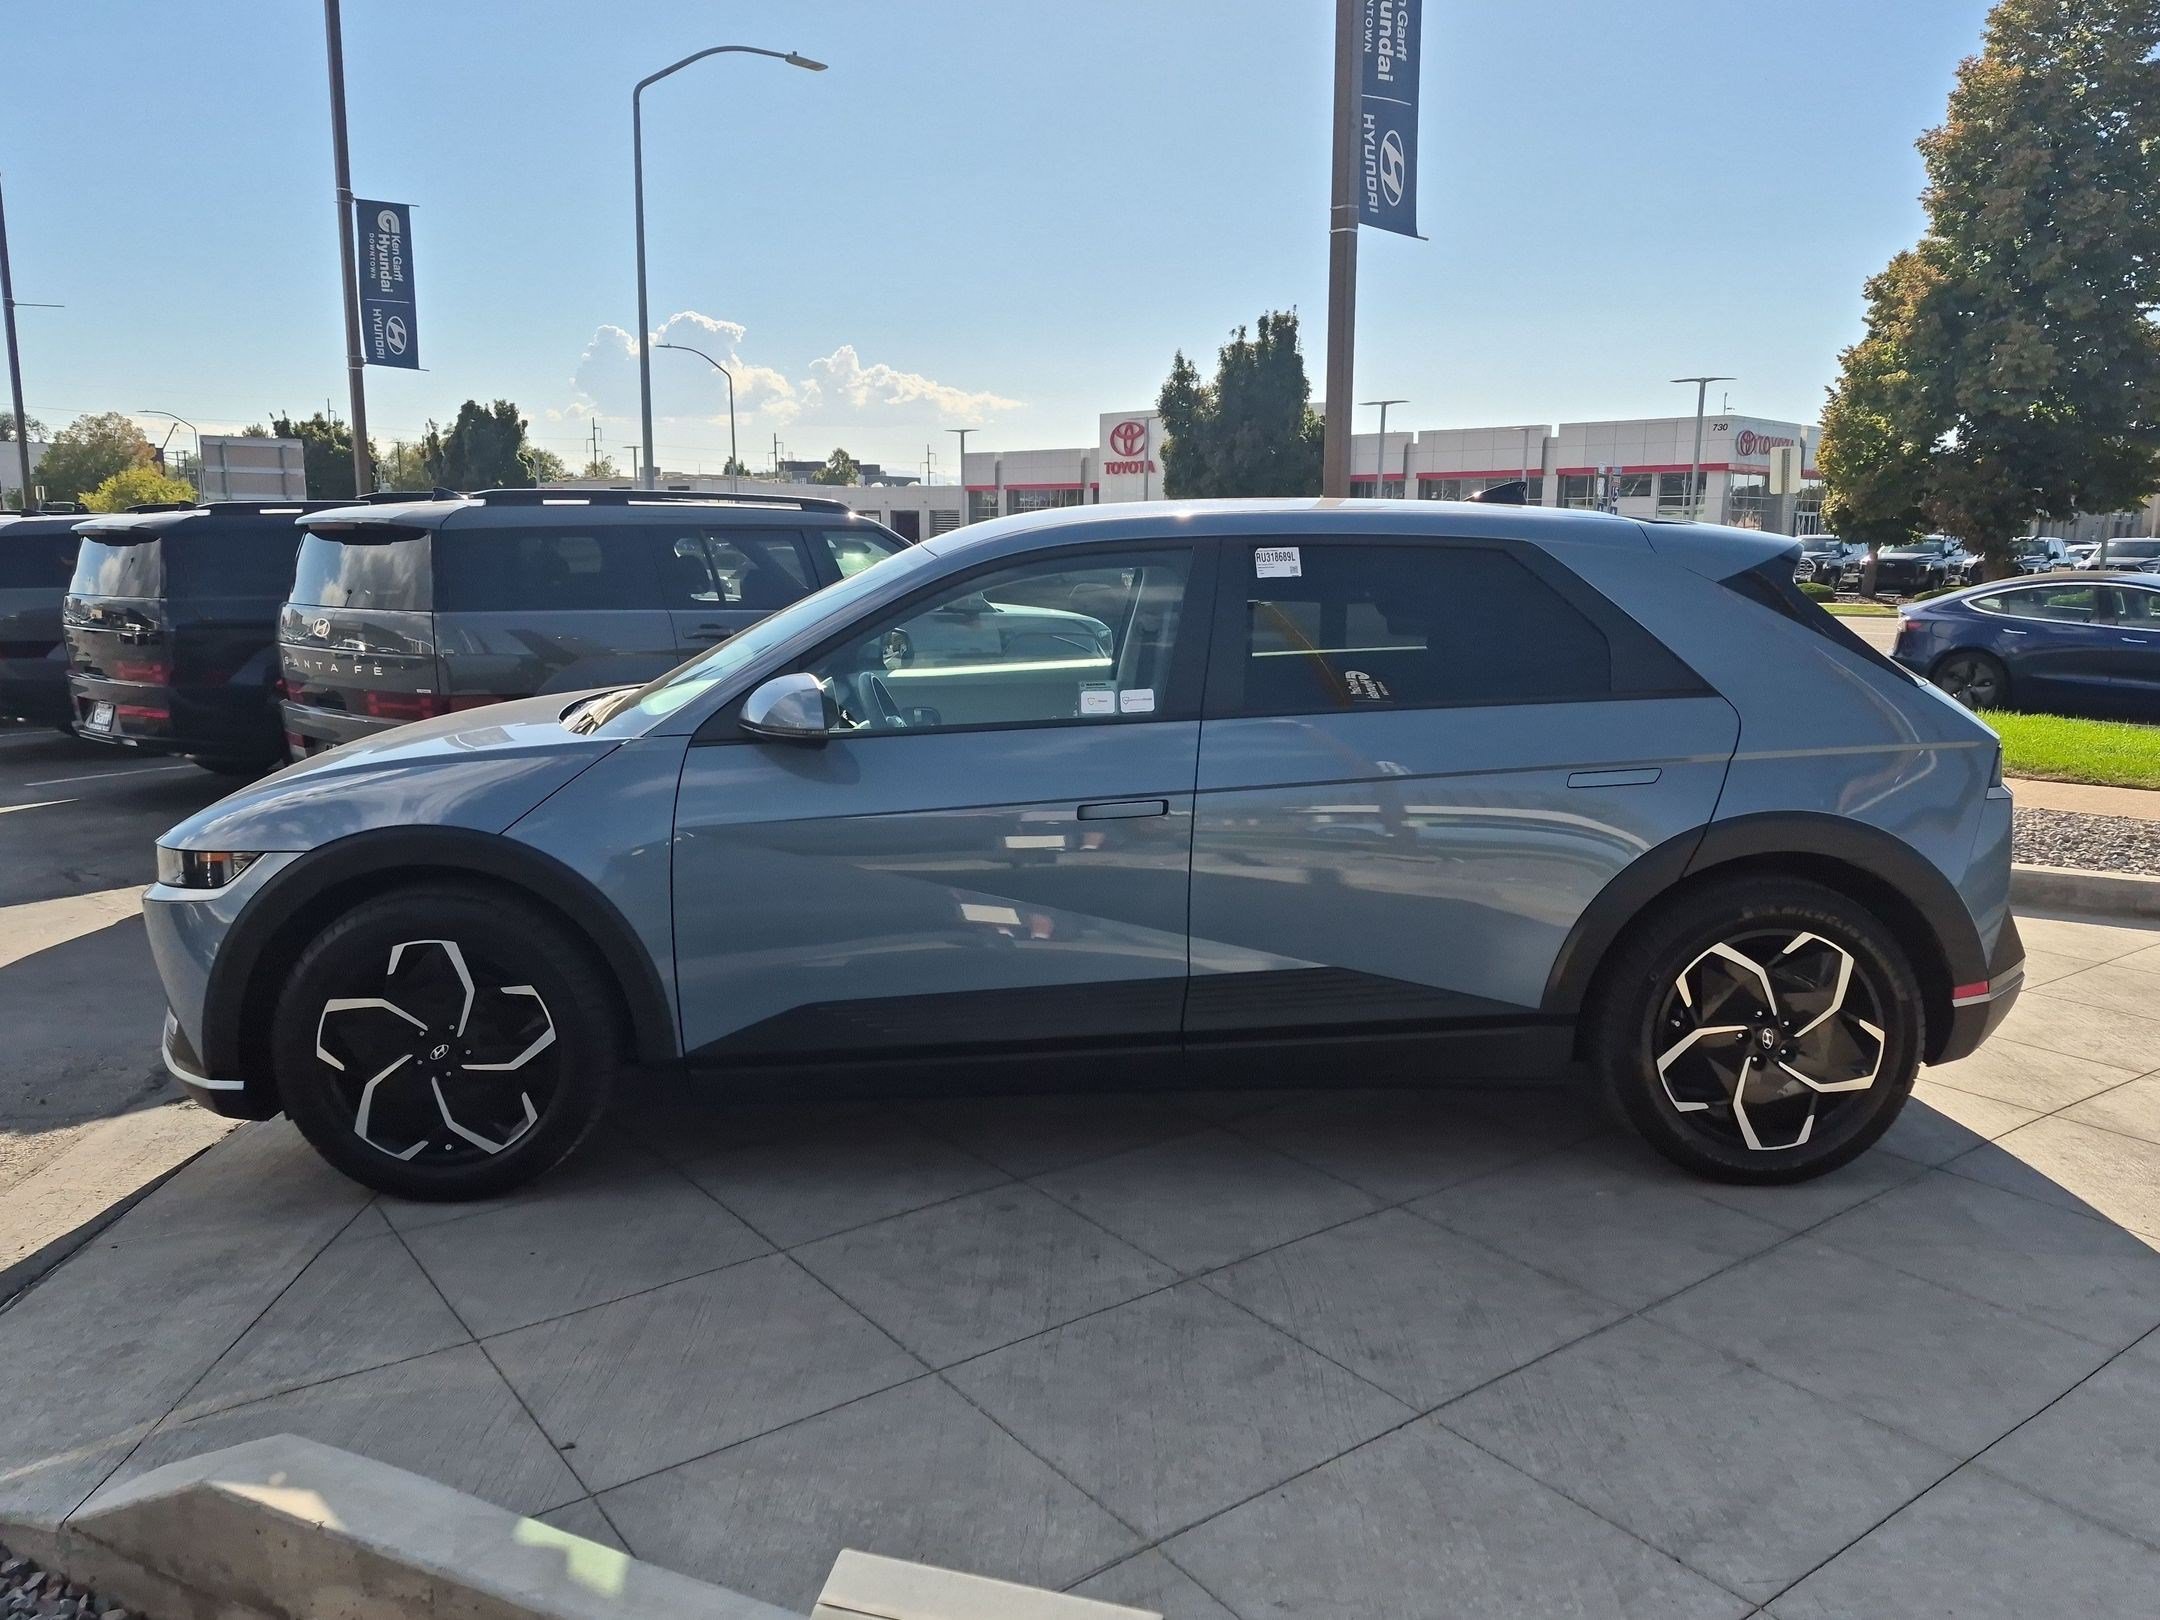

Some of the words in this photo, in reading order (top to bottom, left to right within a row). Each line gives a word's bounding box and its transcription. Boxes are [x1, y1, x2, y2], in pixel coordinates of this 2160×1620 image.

[1378, 0, 1394, 82] undai
[1396, 10, 1408, 61] Garff
[1363, 113, 1379, 214] HYUNDAI
[369, 232, 377, 279] DOWNTOWN
[376, 234, 394, 292] Hyundai
[391, 235, 401, 255] Ken
[393, 256, 403, 281] Garff
[373, 308, 386, 360] HYUNDAI
[1712, 423, 1729, 432] 730
[1104, 460, 1156, 475] TOYOTA
[284, 656, 339, 673] SANTA
